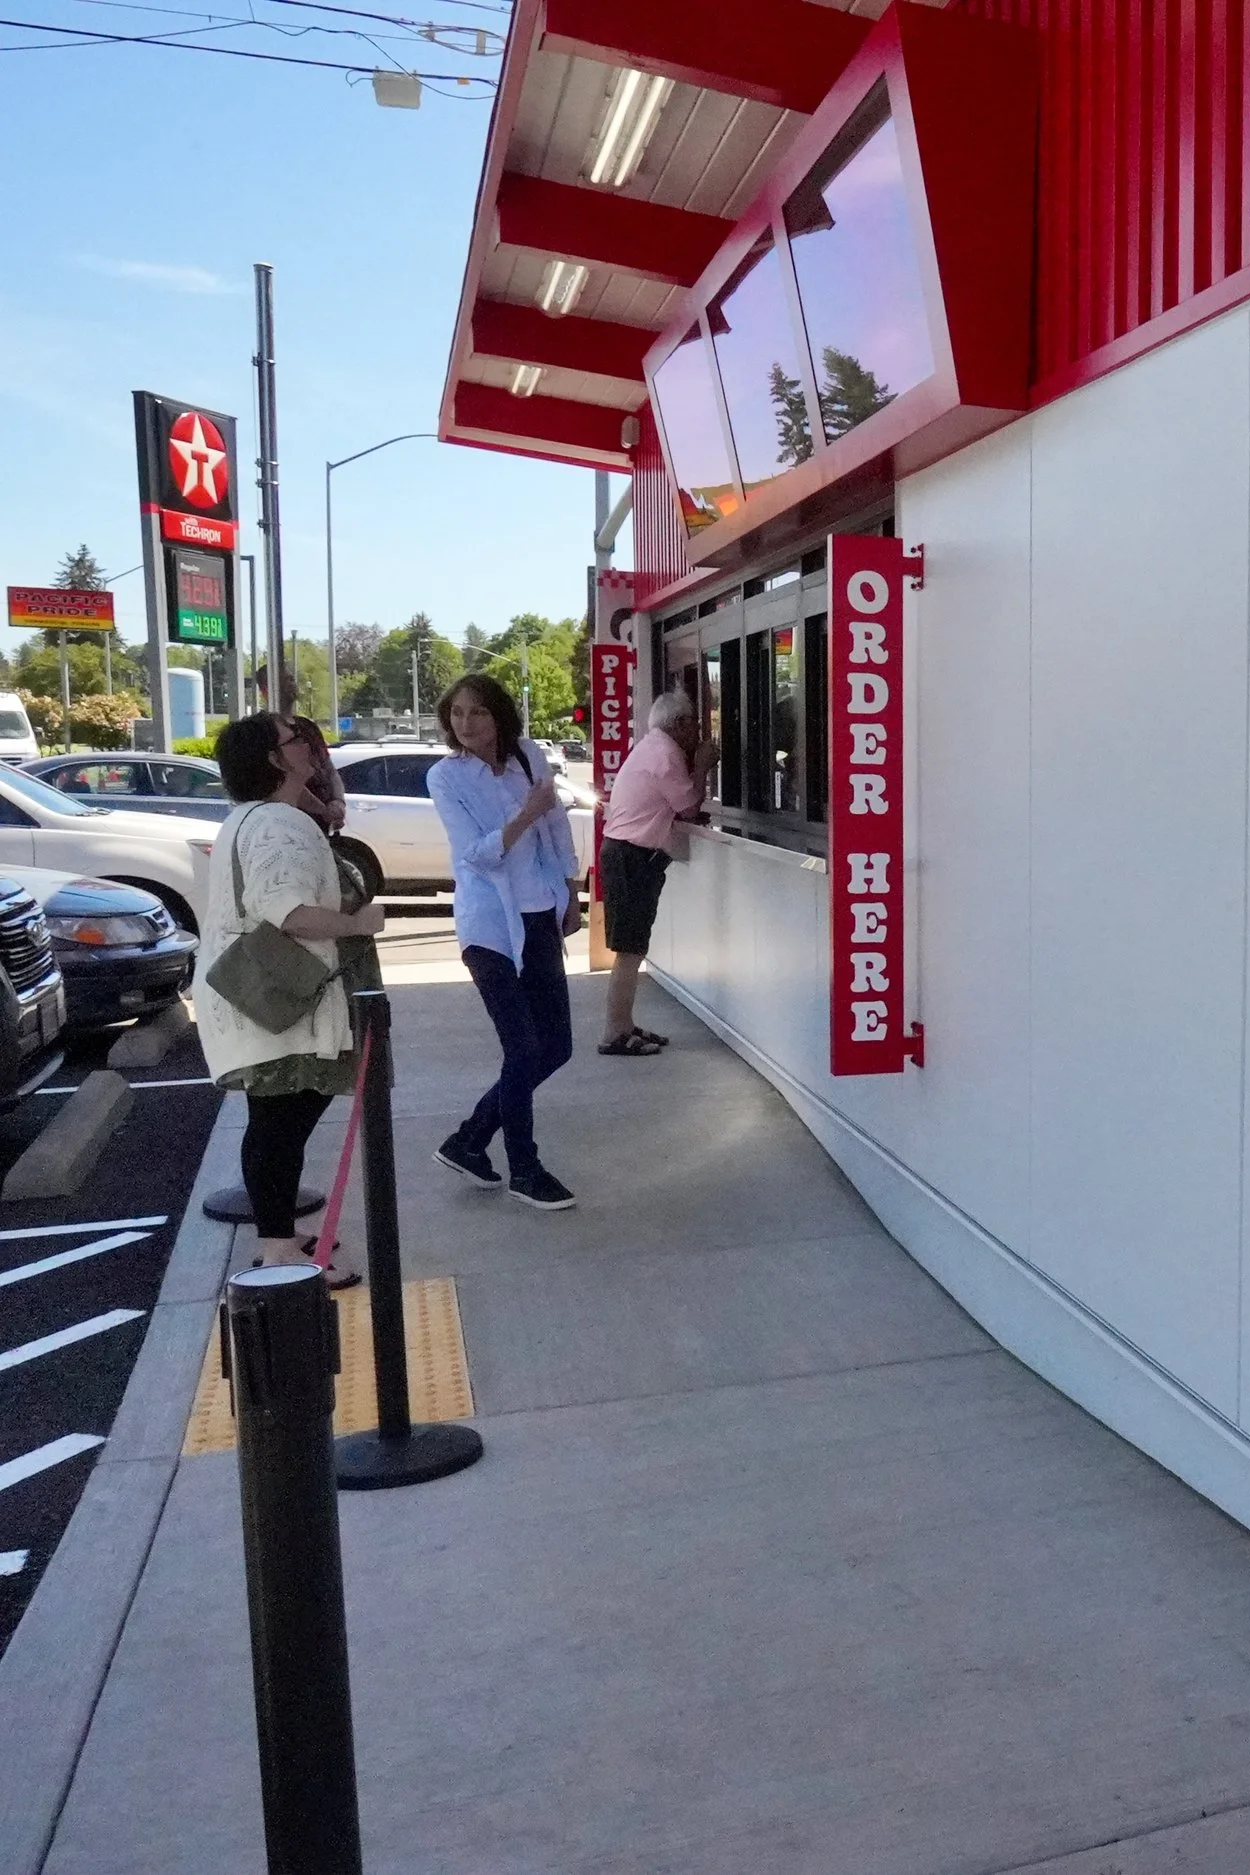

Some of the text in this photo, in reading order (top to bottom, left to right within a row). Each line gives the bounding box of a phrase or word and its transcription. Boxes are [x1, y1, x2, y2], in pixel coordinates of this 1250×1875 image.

[180, 521, 221, 543] TECHRON
[15, 592, 107, 605] PACIFIC
[27, 605, 97, 616] PRIDE
[601, 654, 622, 741] PICK
[847, 570, 890, 1042] ORDER HERE
